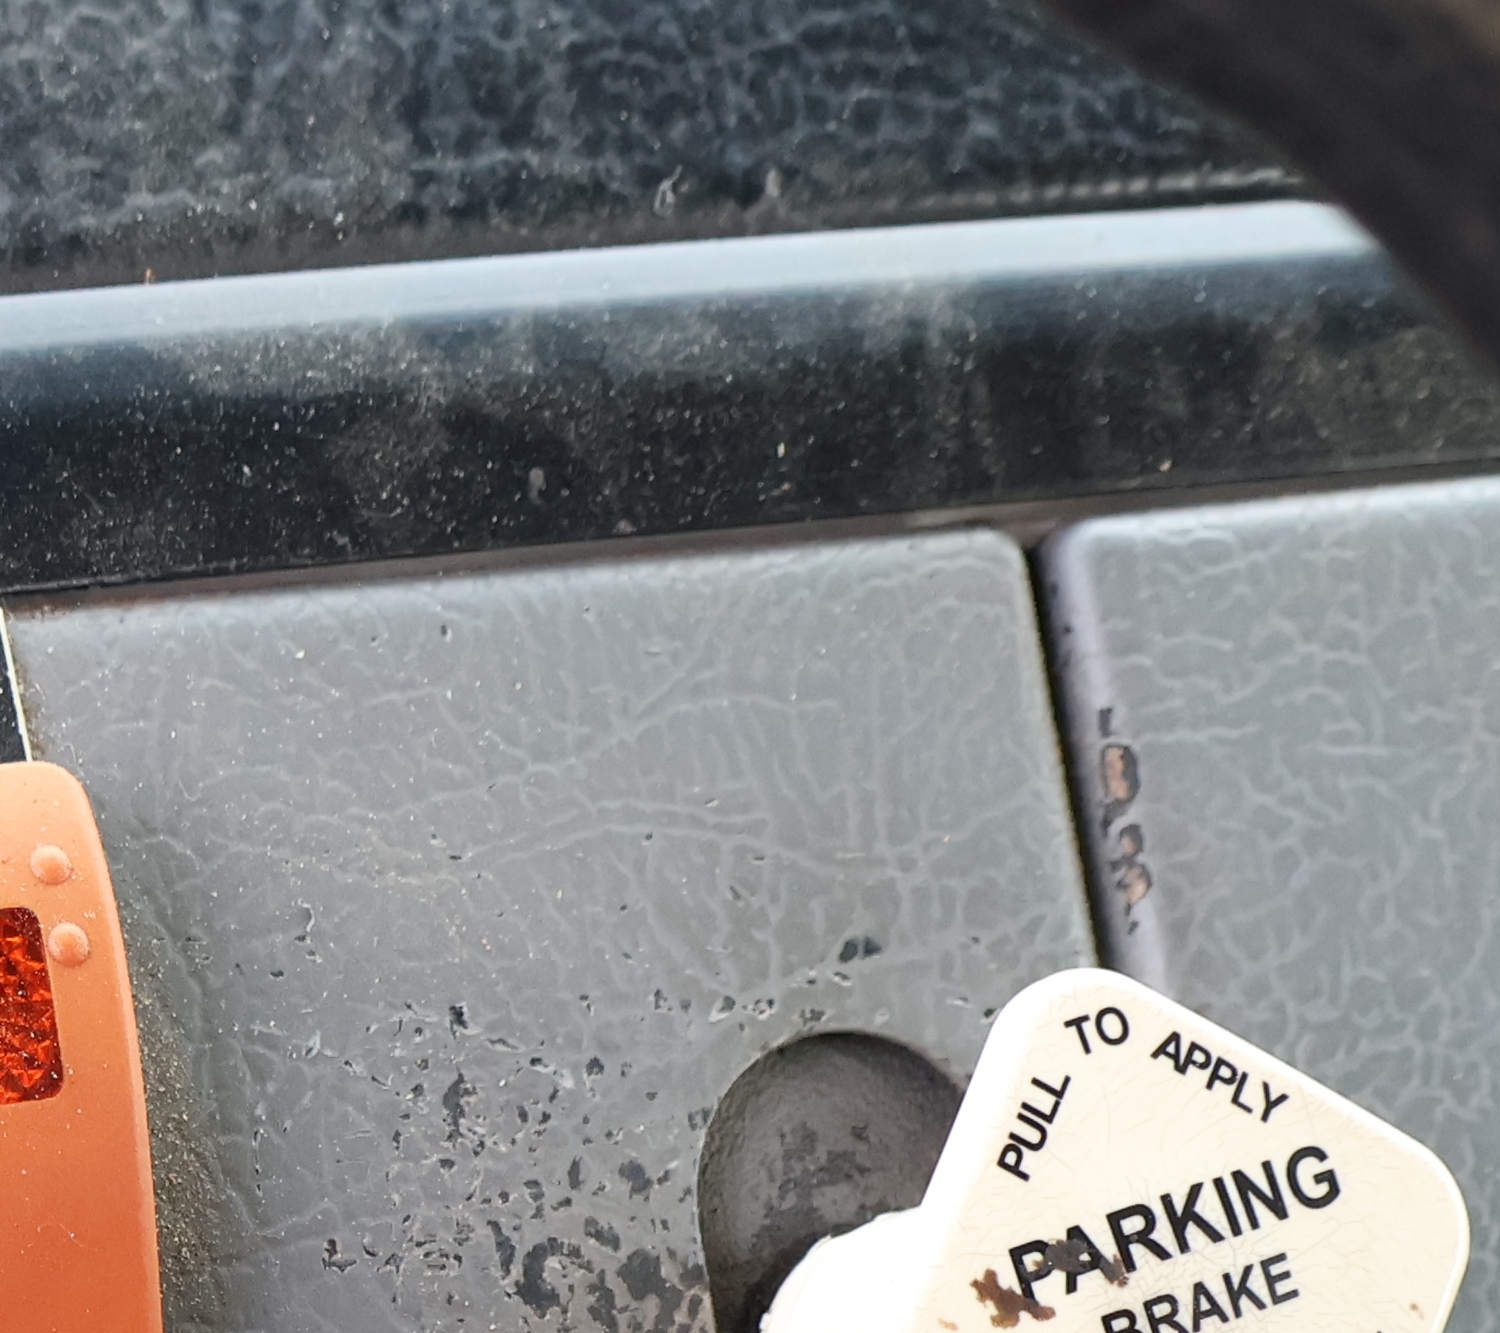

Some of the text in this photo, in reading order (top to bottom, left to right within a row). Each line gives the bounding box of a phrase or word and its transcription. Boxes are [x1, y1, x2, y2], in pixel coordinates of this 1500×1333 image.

[996, 1006, 1289, 1181] PULL TO APPLY
[1009, 1145, 1341, 1303] PARKING
